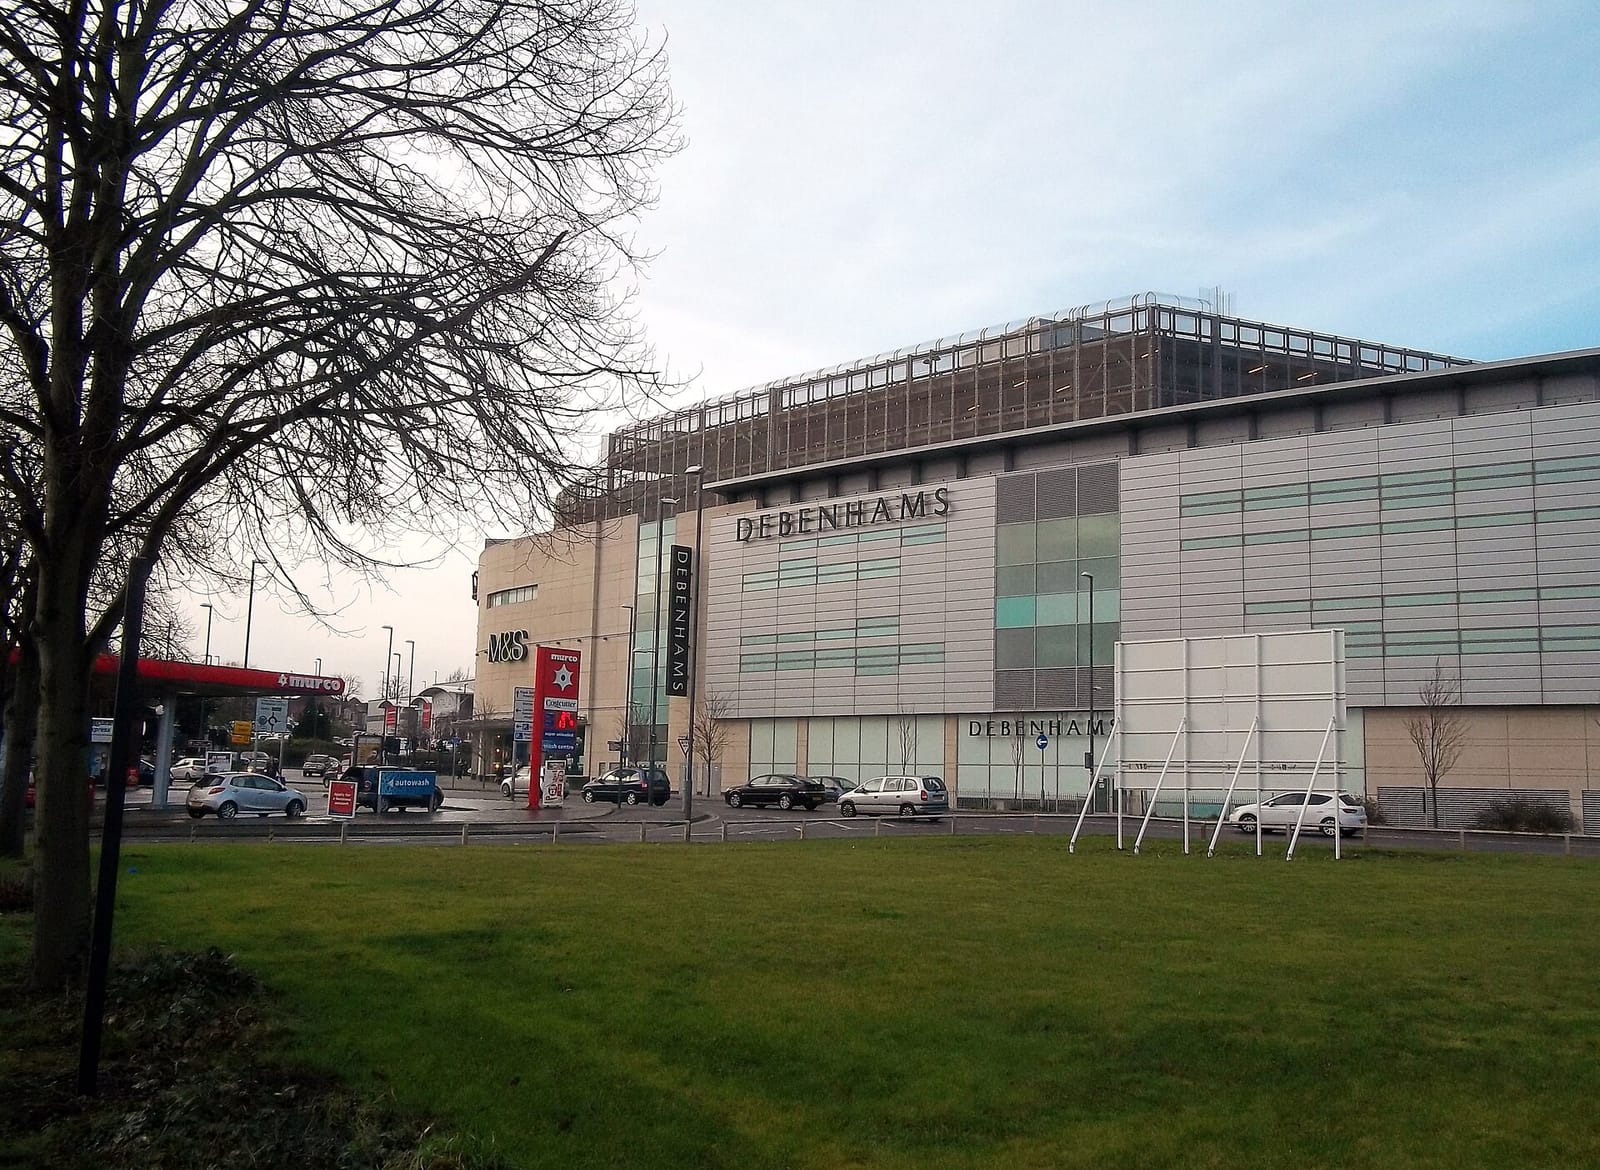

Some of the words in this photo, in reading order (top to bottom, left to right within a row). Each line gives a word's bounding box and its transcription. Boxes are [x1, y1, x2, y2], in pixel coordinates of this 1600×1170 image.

[735, 487, 949, 542] DEBENHAMS
[672, 551, 689, 691] DEBENHAMS
[487, 629, 529, 664] M&S
[551, 654, 578, 662] murco
[289, 675, 341, 691] murco
[395, 778, 430, 786] autowash
